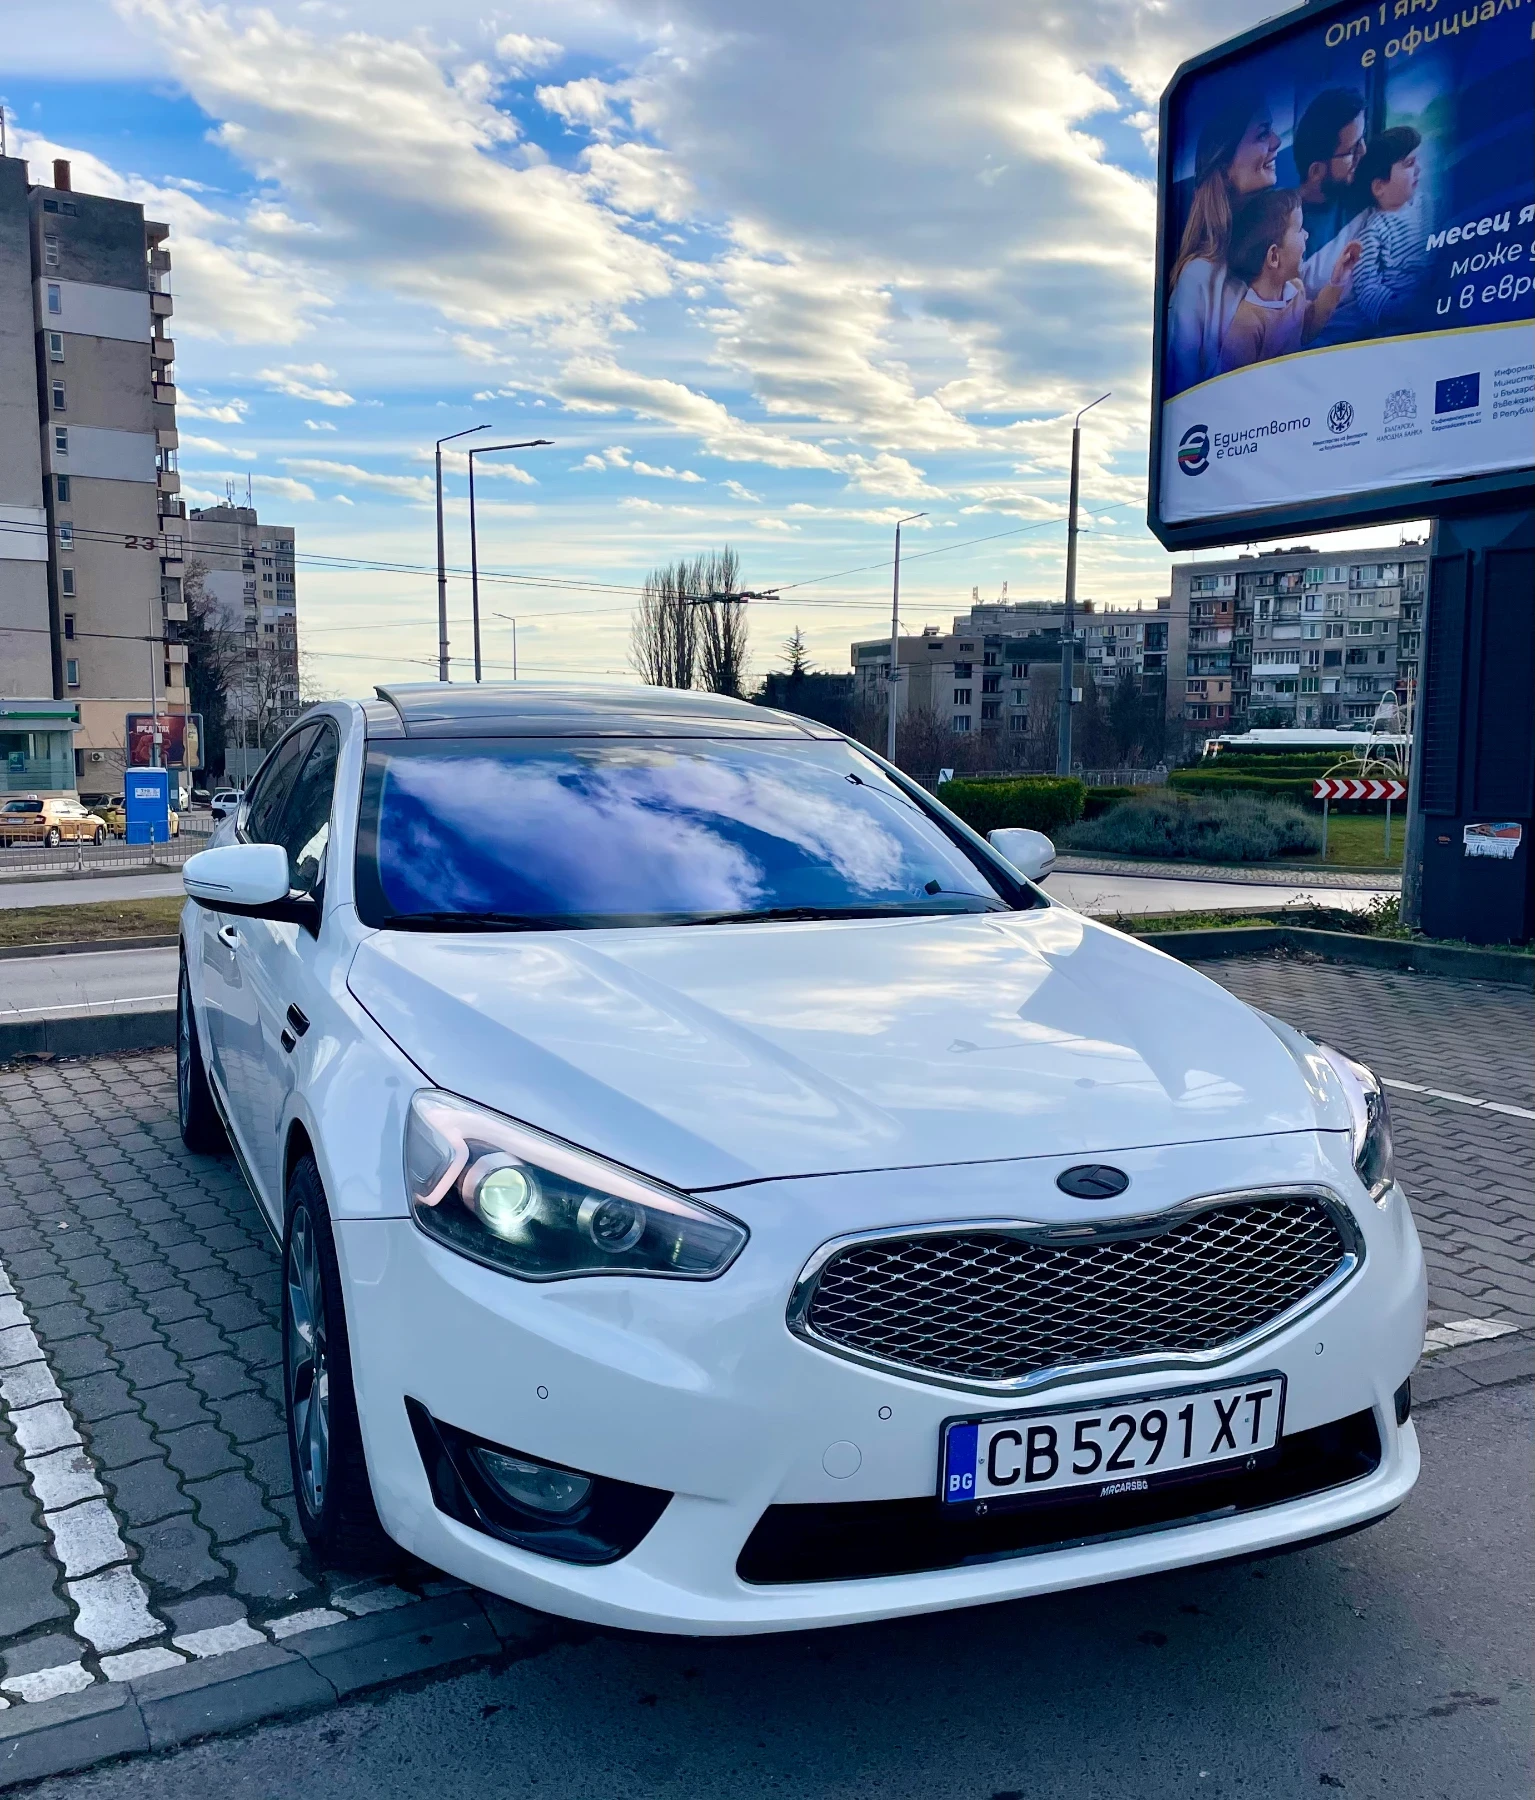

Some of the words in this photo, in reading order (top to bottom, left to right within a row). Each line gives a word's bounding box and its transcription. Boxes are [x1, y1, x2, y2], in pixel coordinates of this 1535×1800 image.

[1325, 15, 1370, 47] От
[1378, 2, 1387, 26] 1
[1361, 48, 1376, 68] е
[1425, 211, 1511, 252] месец
[1450, 242, 1523, 279] може
[1436, 296, 1452, 315] и
[1459, 284, 1475, 309] в
[1481, 274, 1535, 302] евр
[1493, 374, 1535, 388] Министе
[1214, 417, 1311, 448] Единството
[1216, 449, 1225, 459] е
[1227, 442, 1258, 457] сила
[125, 535, 154, 550] 23
[987, 1425, 1059, 1487] CB
[1072, 1403, 1195, 1475] 5291
[1209, 1388, 1273, 1454] XT
[949, 1473, 973, 1492] BG
